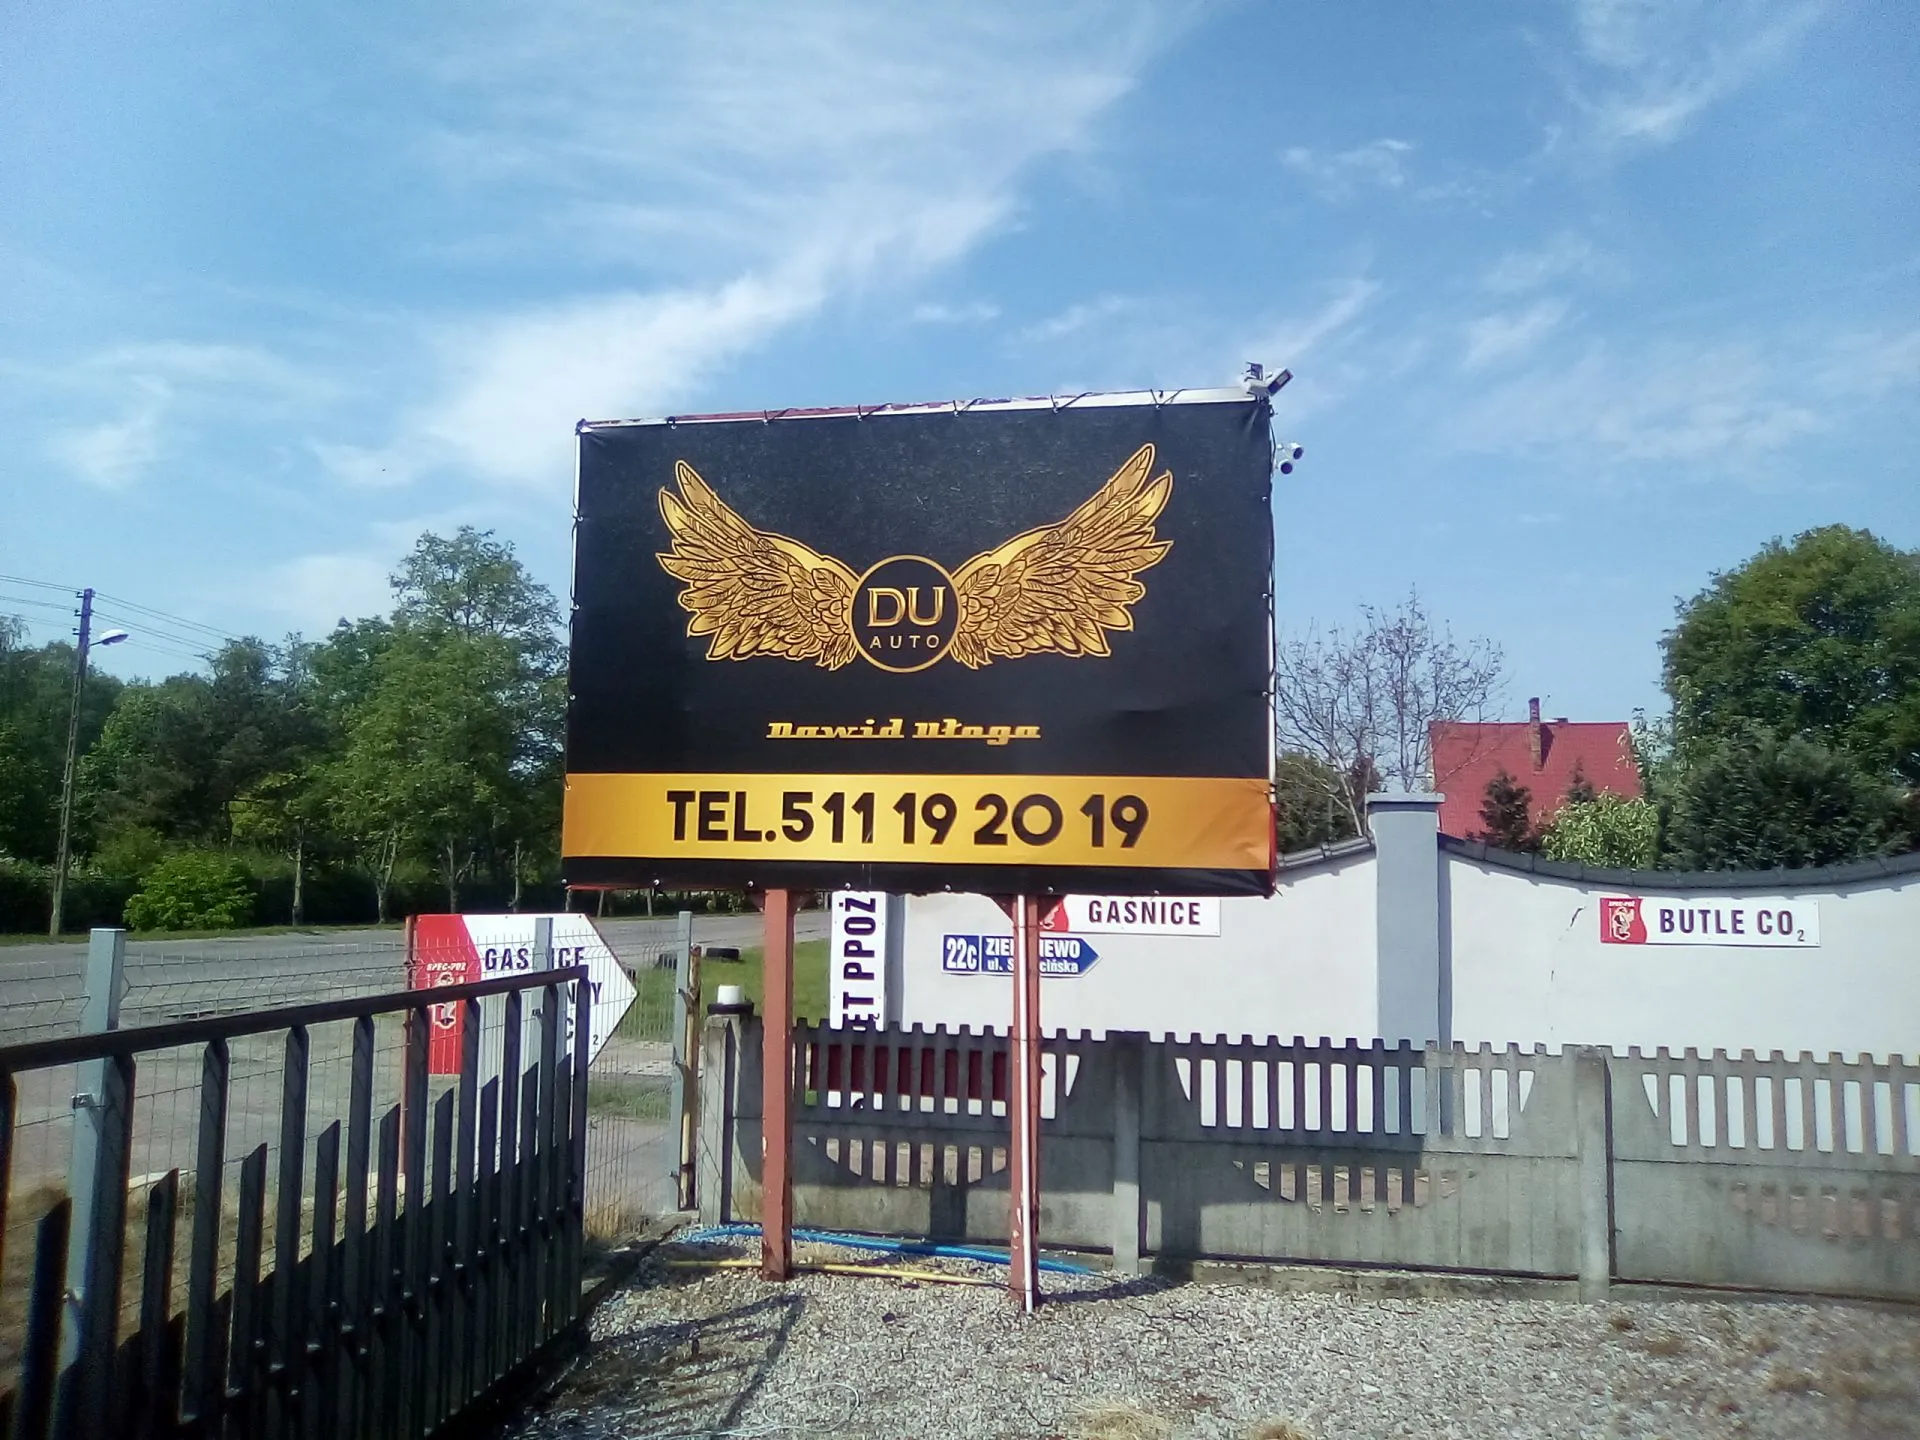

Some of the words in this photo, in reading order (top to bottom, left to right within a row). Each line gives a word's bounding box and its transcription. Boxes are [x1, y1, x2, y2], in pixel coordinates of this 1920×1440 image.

[867, 586, 946, 627] DU
[869, 635, 941, 649] AUTO
[766, 718, 905, 739] Dawid
[893, 792, 957, 845] 19
[974, 793, 1064, 846] 20
[1080, 794, 1149, 848] 19
[1659, 908, 1745, 934] BUTLE
[985, 938, 1081, 959] ZIEIEWO
[987, 959, 1003, 971] ul.
